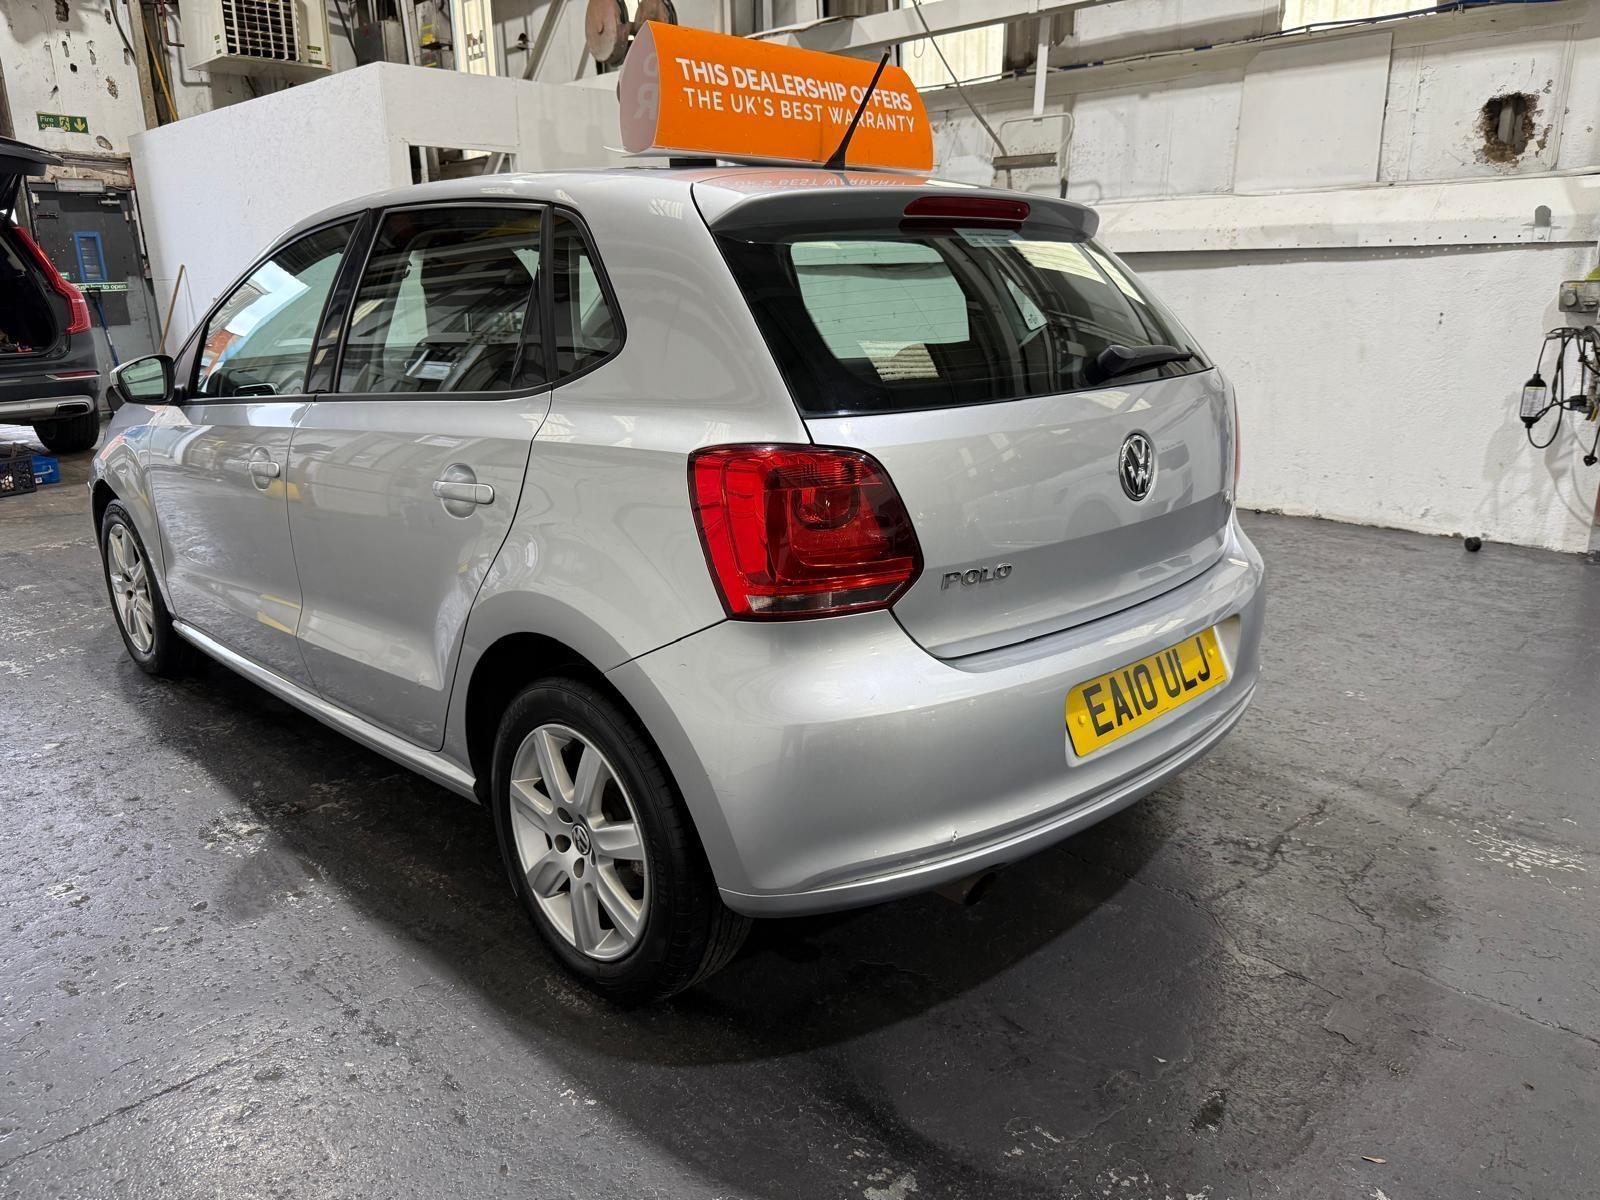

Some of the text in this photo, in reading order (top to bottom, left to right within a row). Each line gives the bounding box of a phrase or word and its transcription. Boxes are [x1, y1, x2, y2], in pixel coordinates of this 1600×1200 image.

[675, 57, 729, 86] THIS
[731, 66, 847, 102] DEALERSHIP
[40, 115, 54, 123] Fire
[683, 87, 724, 112] THE
[730, 93, 775, 117] UK'S
[780, 99, 823, 123] BEST
[941, 563, 1012, 591] POLO
[1082, 637, 1211, 737] EA10 ULJ
